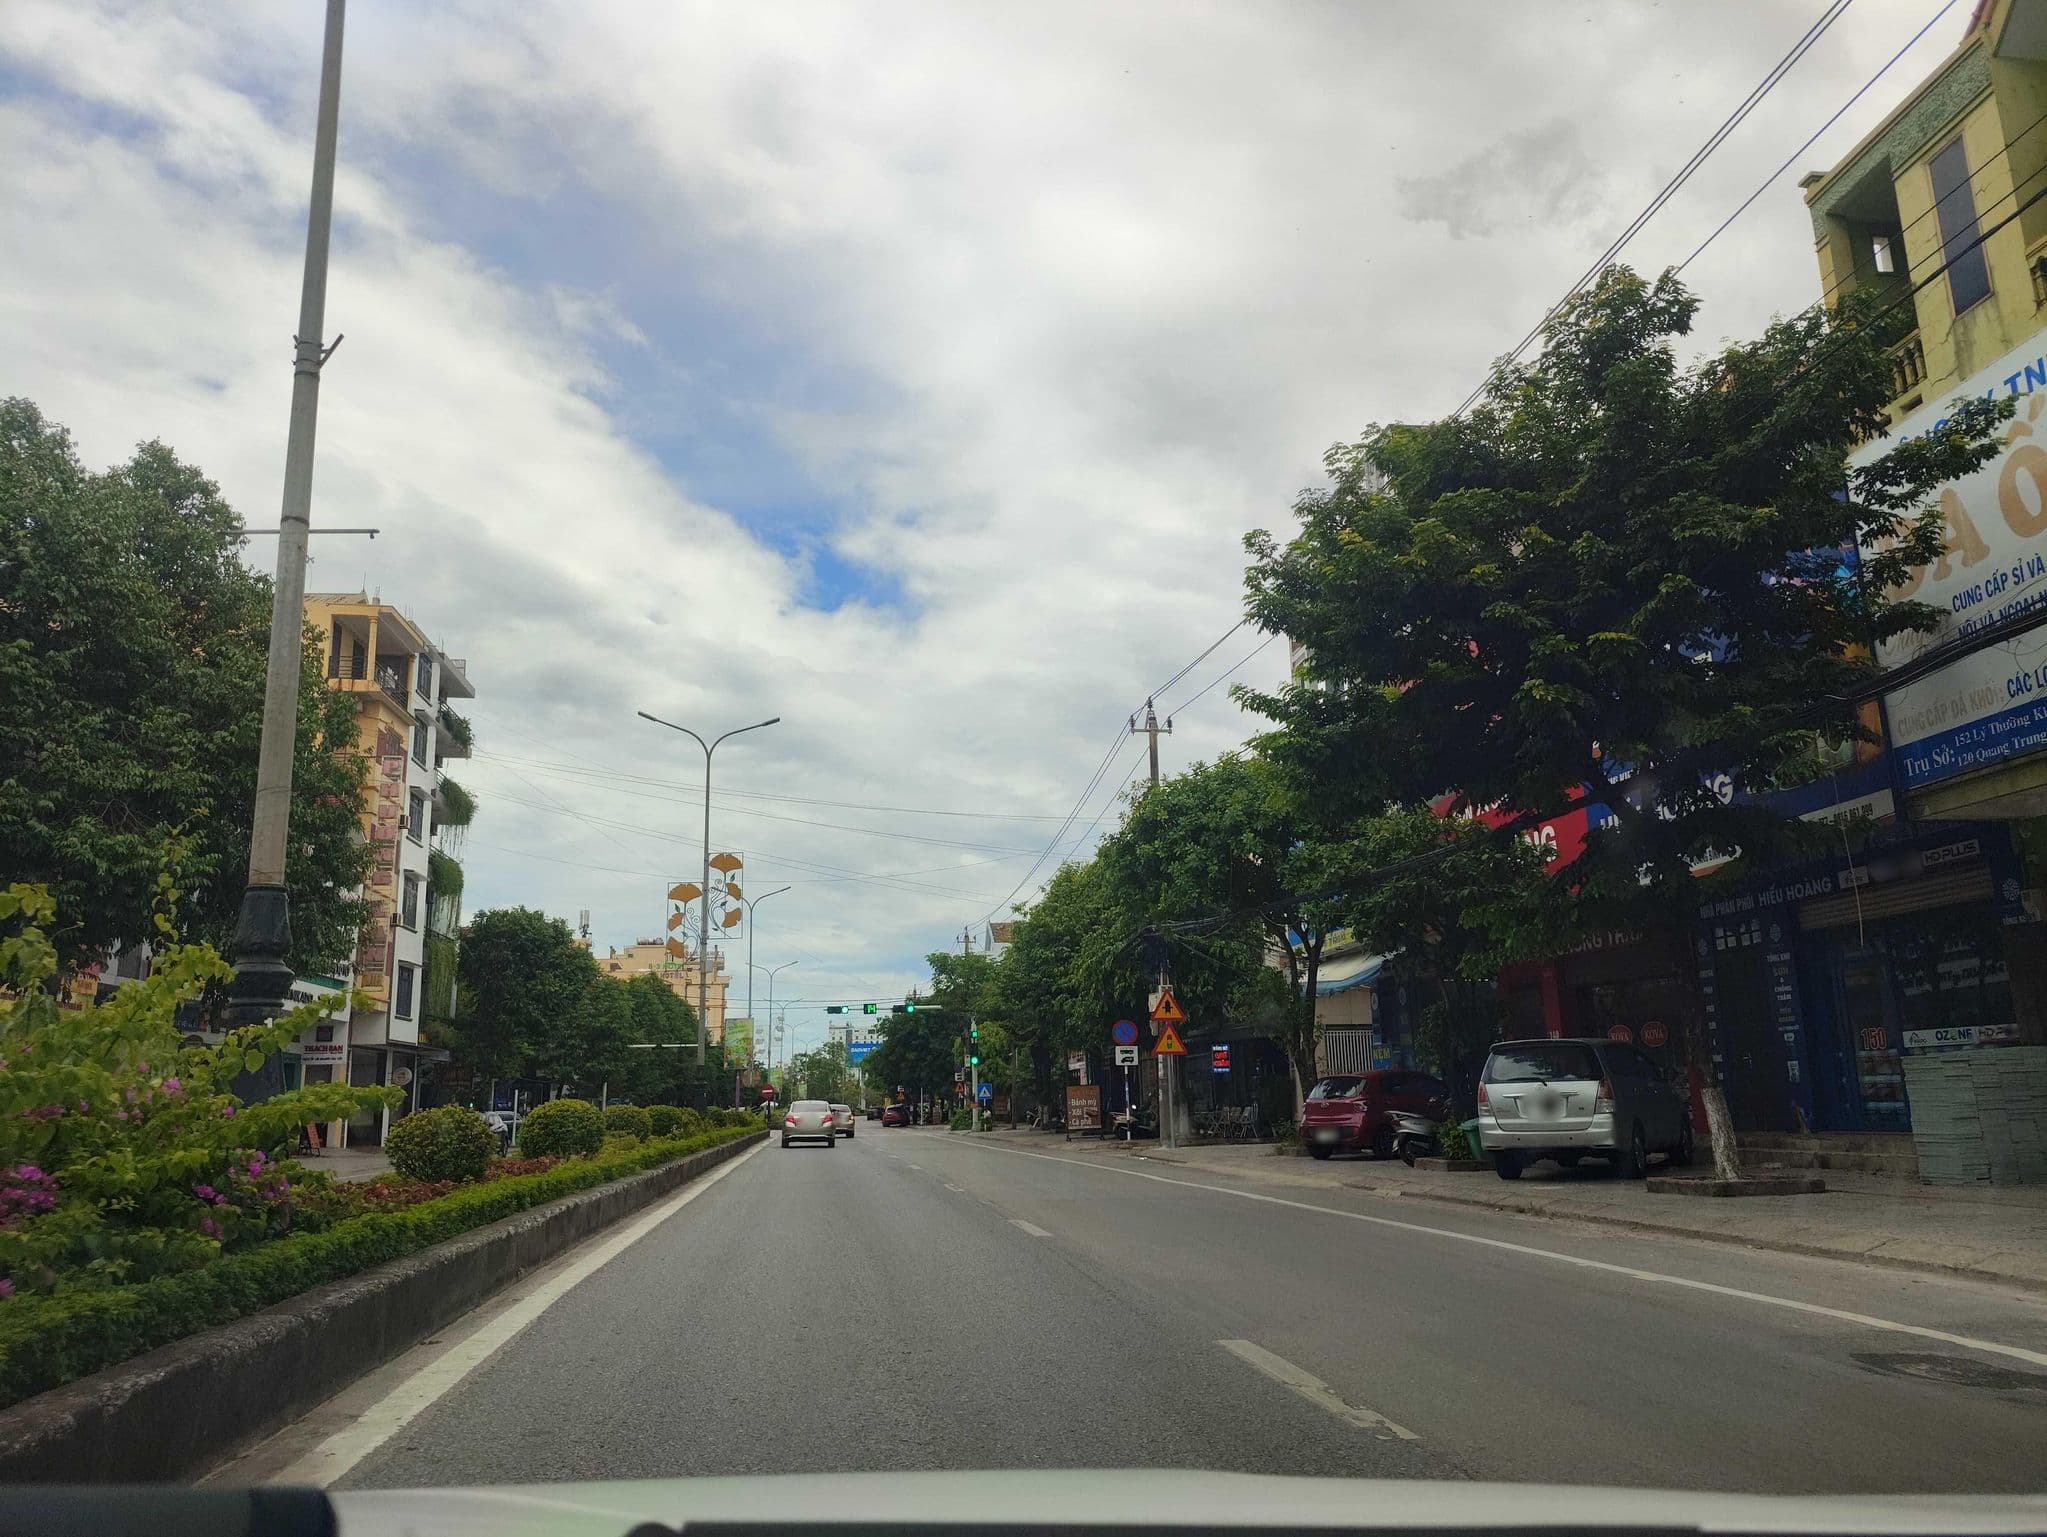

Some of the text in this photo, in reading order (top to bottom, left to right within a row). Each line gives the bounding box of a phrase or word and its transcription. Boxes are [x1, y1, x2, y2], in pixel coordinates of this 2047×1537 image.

[1952, 585, 1983, 613] CUNG
[1985, 568, 2008, 598] CẤP
[2007, 671, 2032, 699] CÁC
[1954, 731, 1972, 747] 152
[1903, 757, 1931, 777] Trụ
